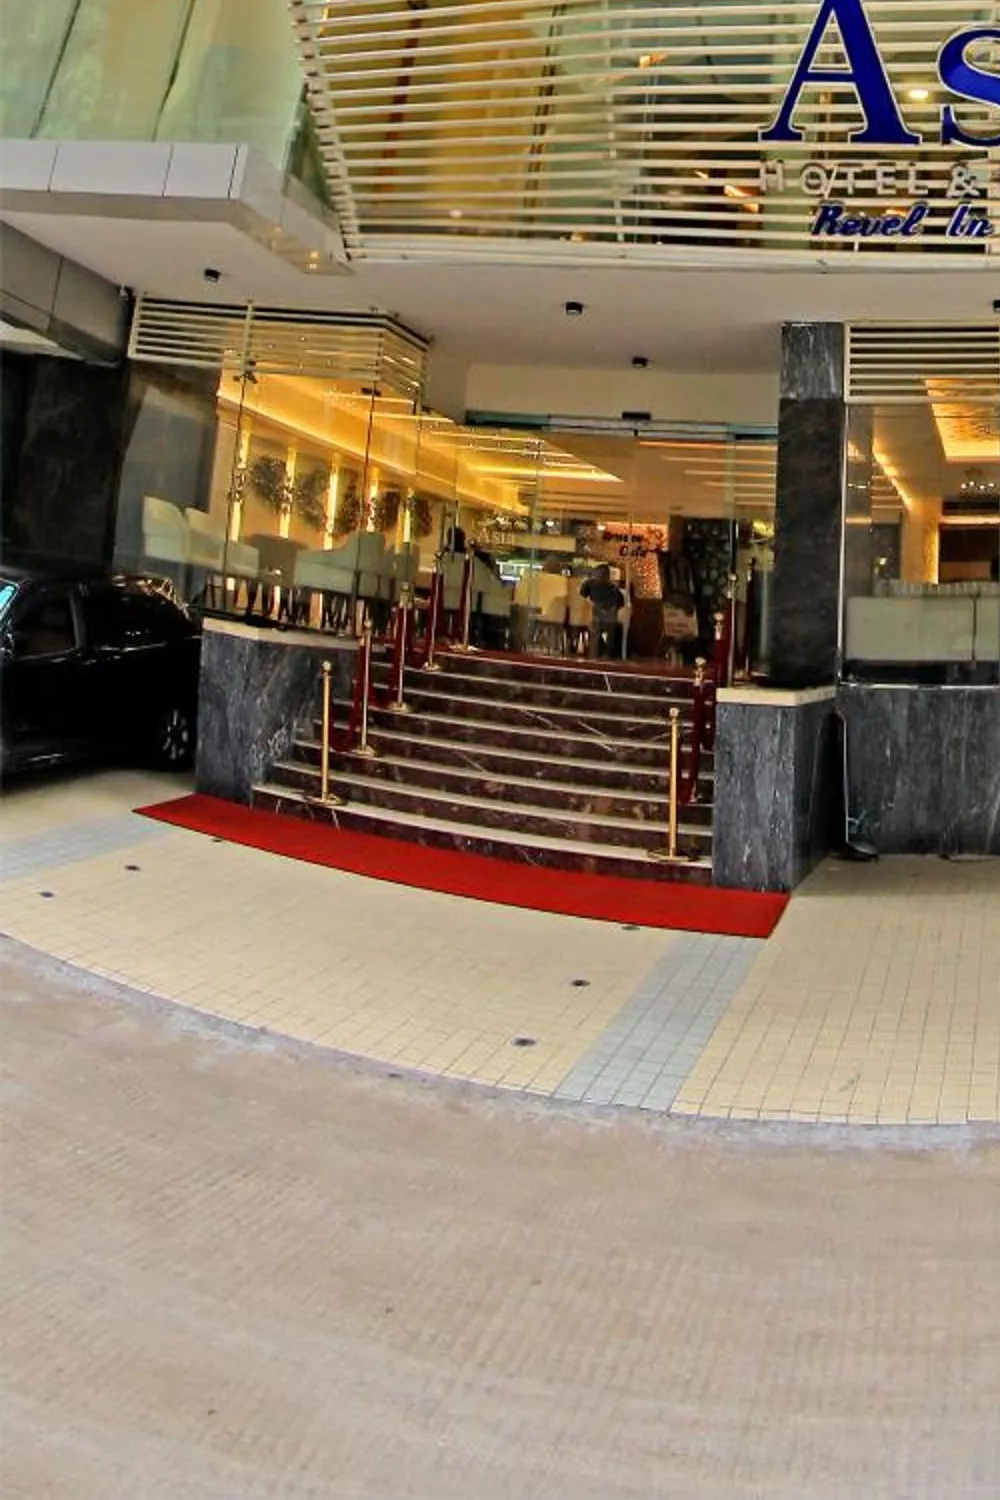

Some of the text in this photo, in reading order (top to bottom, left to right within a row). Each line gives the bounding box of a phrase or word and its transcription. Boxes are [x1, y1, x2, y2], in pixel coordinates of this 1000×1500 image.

[759, 160, 929, 196] HOTEL
[945, 162, 981, 198] &
[811, 202, 930, 238] Revel
[945, 202, 994, 239] In
